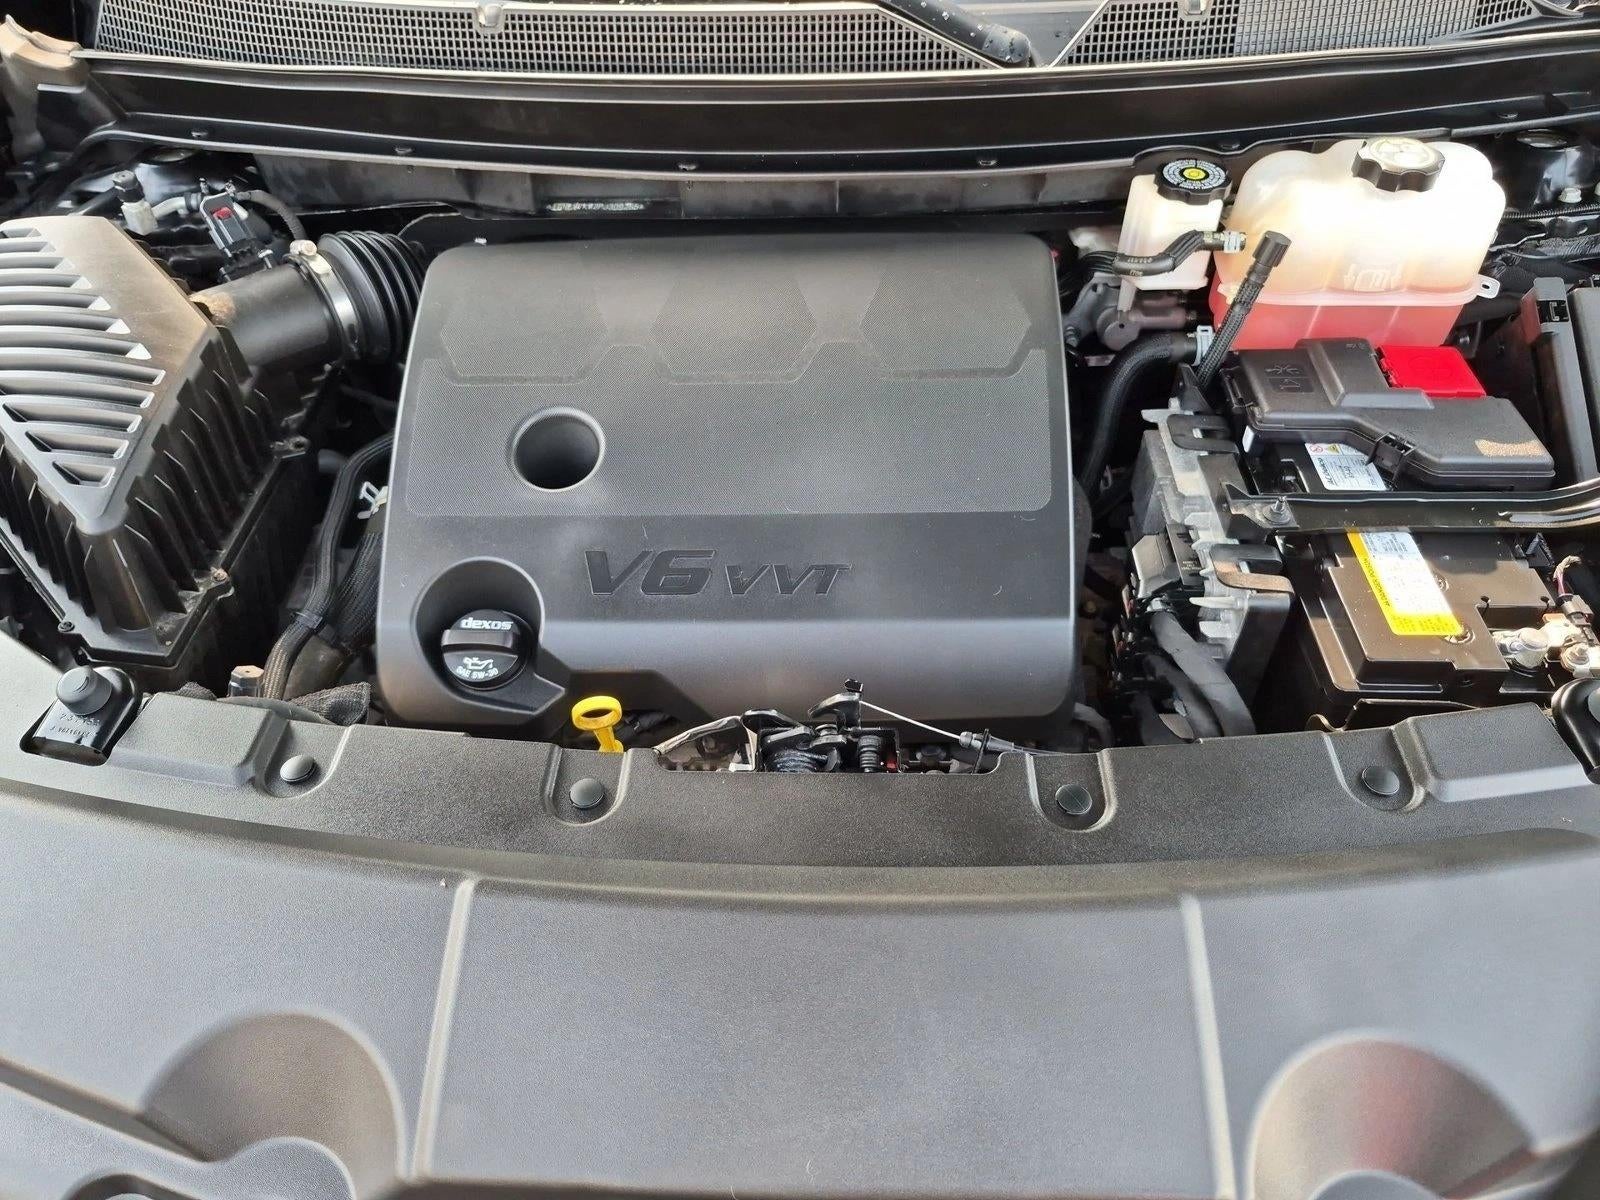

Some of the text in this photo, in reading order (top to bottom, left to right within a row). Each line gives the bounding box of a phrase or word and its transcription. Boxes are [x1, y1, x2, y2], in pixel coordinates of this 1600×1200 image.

[584, 549, 852, 597] V6 VVT
[460, 617, 514, 630] dexos
[456, 665, 499, 679] SAE 5W-30
